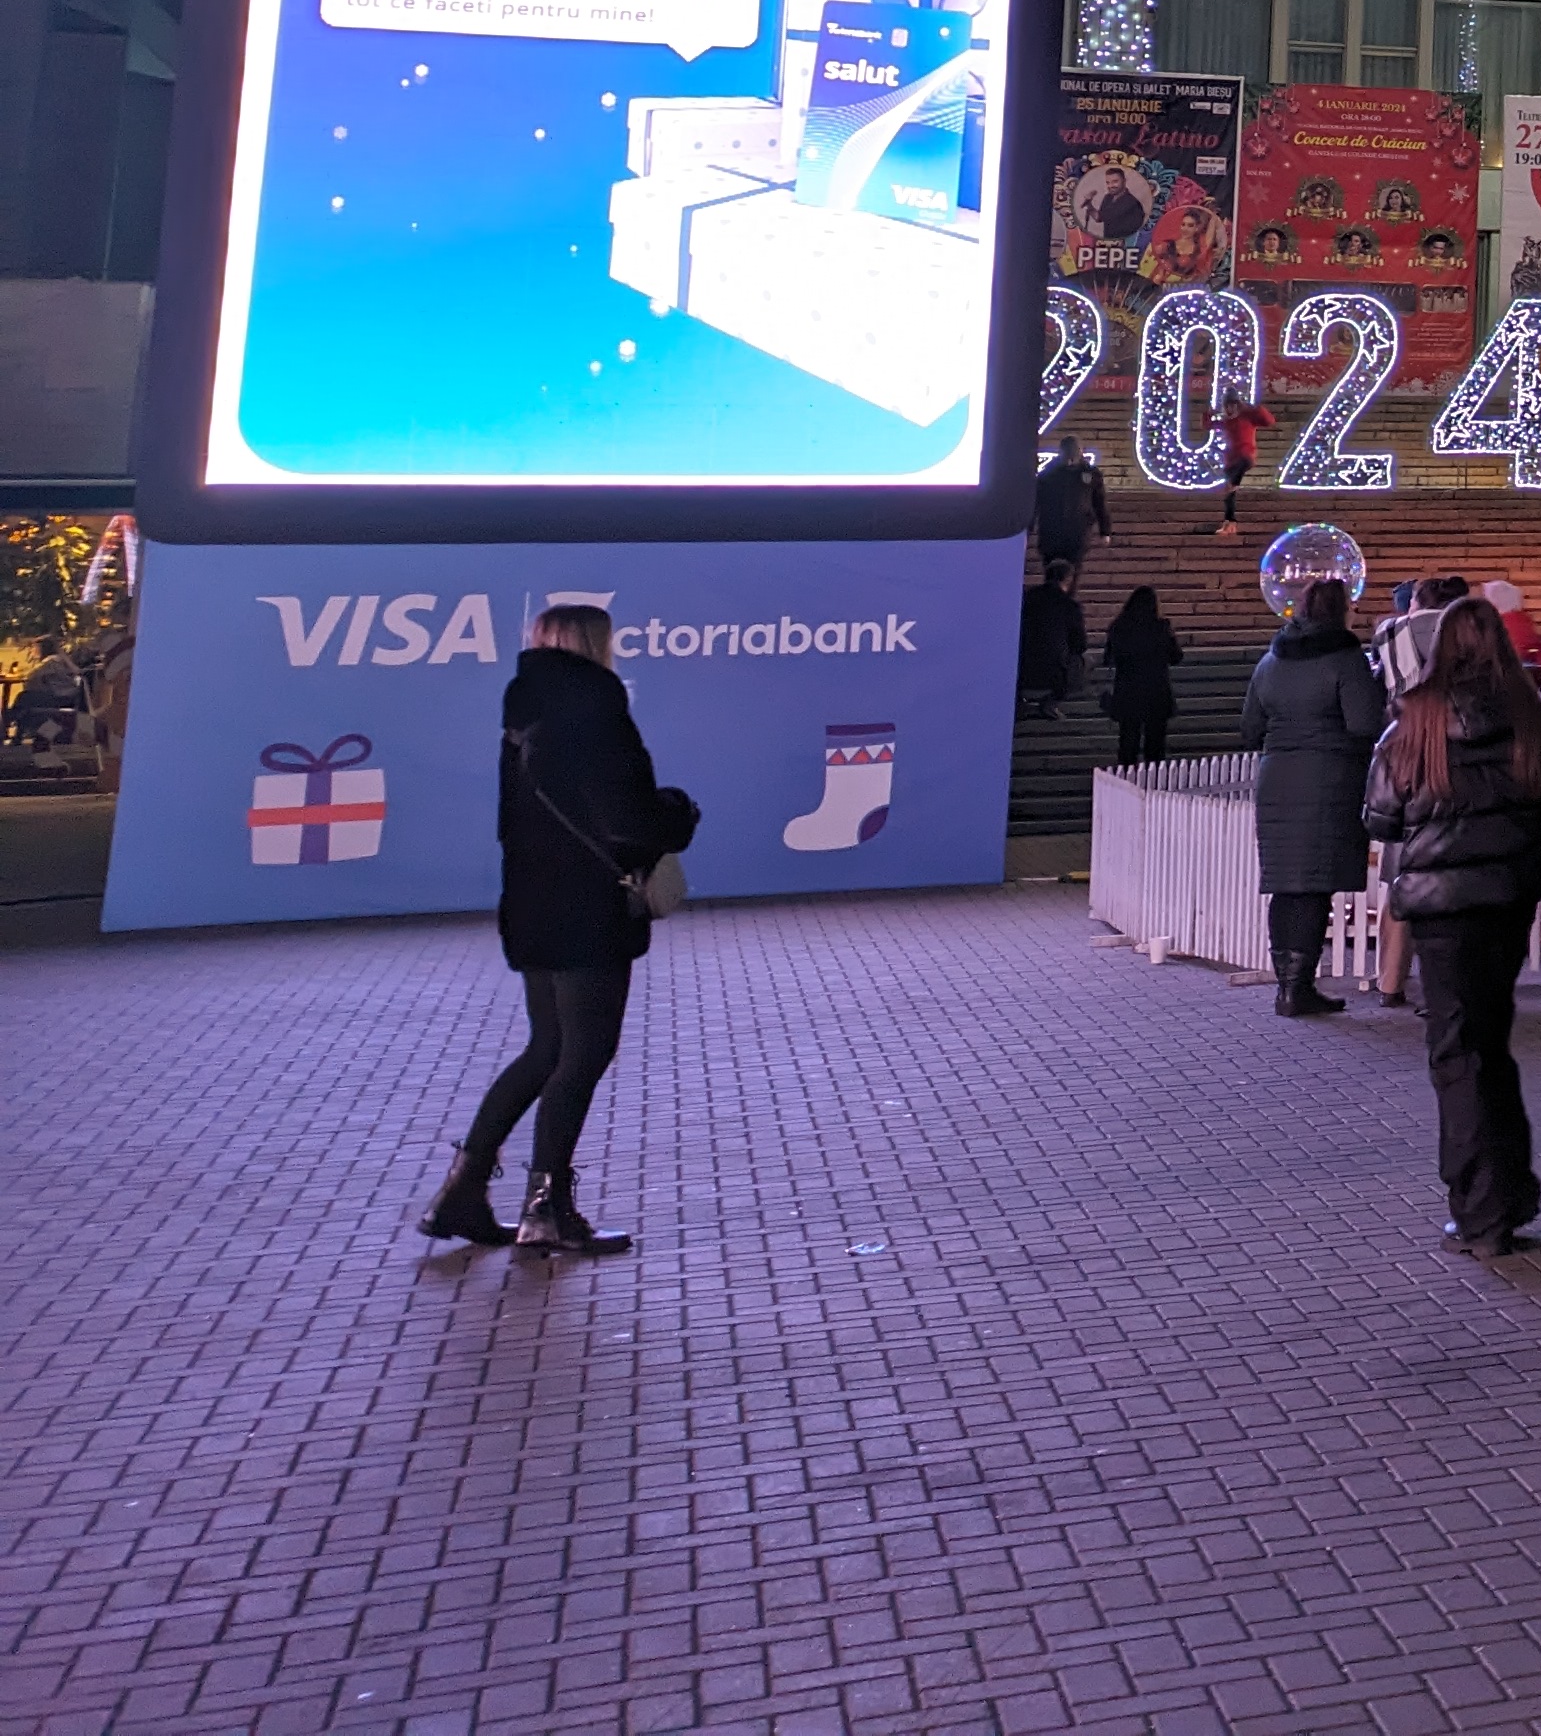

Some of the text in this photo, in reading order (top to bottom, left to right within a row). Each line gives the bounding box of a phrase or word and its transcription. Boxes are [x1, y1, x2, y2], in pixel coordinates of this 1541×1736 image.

[502, 1, 580, 20] pentru
[590, 6, 655, 23] mine!
[824, 59, 900, 87] salut
[1089, 81, 1101, 93] DE
[1143, 83, 1172, 95] BALET
[1097, 99, 1163, 113] IANUARIE
[1294, 131, 1427, 150] Concert de Crăciun
[890, 183, 949, 211] VISA
[1077, 247, 1140, 270] PEPE
[256, 594, 497, 666] VISA
